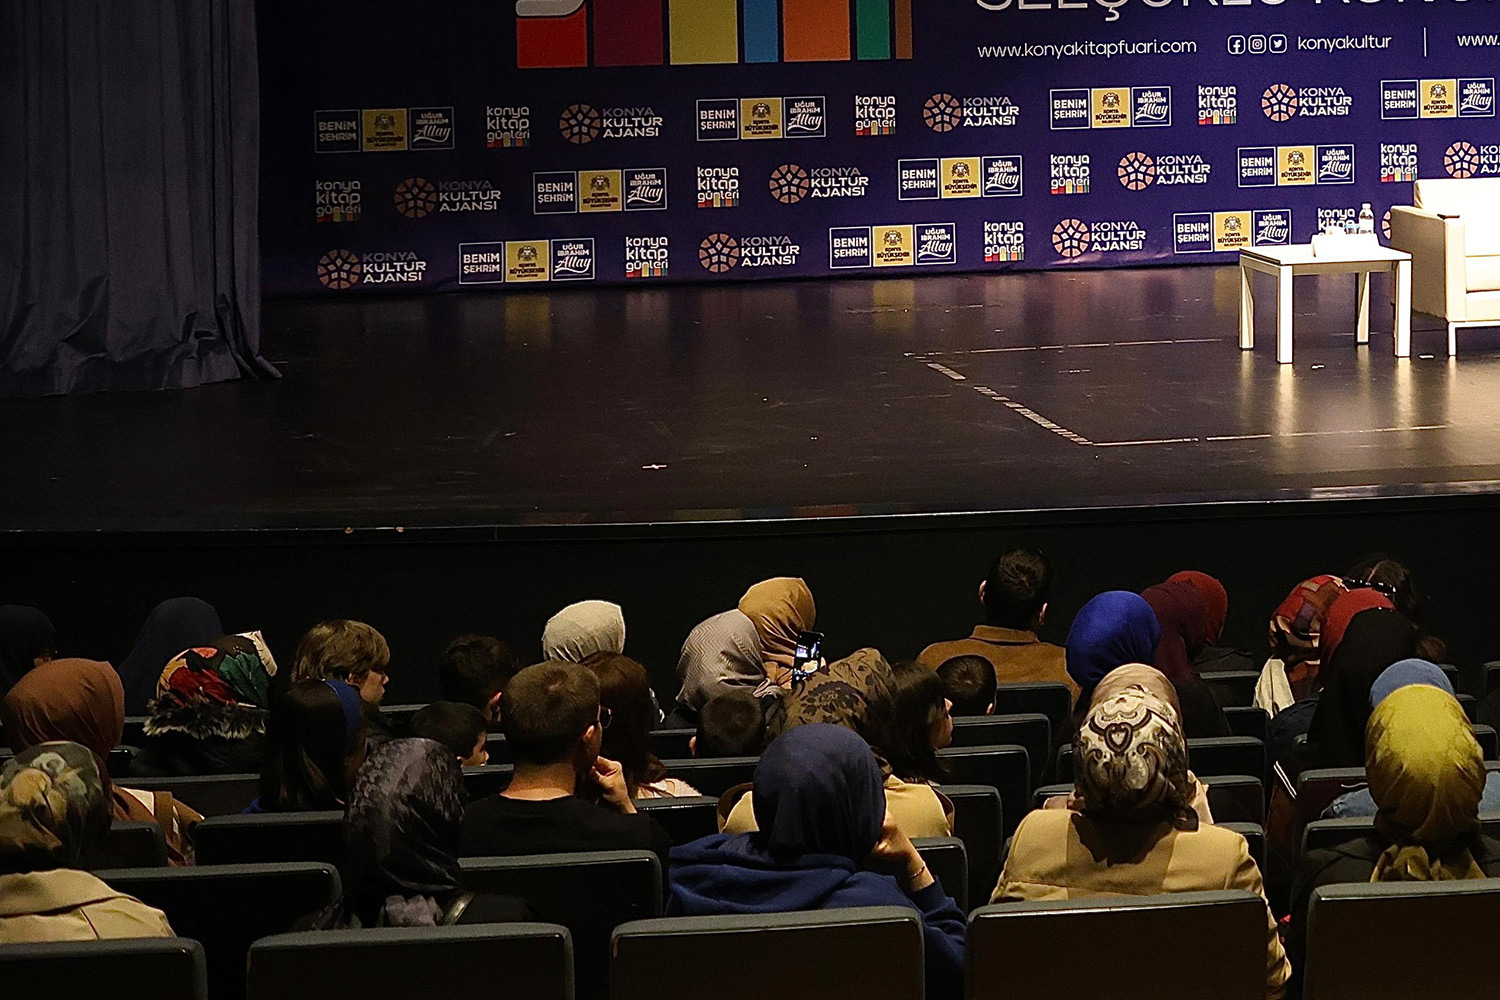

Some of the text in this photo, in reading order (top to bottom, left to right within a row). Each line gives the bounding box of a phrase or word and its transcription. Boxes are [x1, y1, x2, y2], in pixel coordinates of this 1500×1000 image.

[977, 38, 1197, 60] www.konyakitapfuari.com
[1297, 33, 1393, 54] konyakultur
[1198, 85, 1236, 97] konya
[1299, 87, 1345, 97] KONYA
[855, 95, 895, 106] konya
[963, 96, 1011, 106] KONYA
[1198, 96, 1236, 110] kitap
[603, 107, 654, 116] KONYA
[855, 106, 895, 119] kitap
[1299, 106, 1349, 116] AJANSI
[963, 116, 1016, 127] AJANSI
[603, 127, 658, 138] AJANSI
[1381, 143, 1417, 154] konya
[1050, 154, 1090, 166] konya
[1156, 154, 1203, 164] KONYA
[1381, 153, 1417, 167] kitap
[697, 167, 738, 179] konya
[811, 166, 861, 176] KONYA
[1051, 164, 1090, 178] kitap
[439, 180, 492, 190] KONYA
[697, 178, 738, 192] kitap
[1156, 174, 1207, 185] AJANSI
[811, 186, 865, 197] AJANSI
[439, 201, 497, 212] AJANSI
[1318, 208, 1355, 220] konya
[984, 222, 1023, 233] konya
[1091, 221, 1138, 231] KONYA
[626, 237, 668, 249] konya
[741, 236, 792, 246] KONYA
[984, 232, 1023, 246] kitap
[1091, 240, 1142, 251] AJANSI
[363, 252, 418, 262] KONYA
[626, 247, 668, 262] kitap
[741, 256, 796, 266] AJANSI
[363, 272, 422, 283] AJANSI
